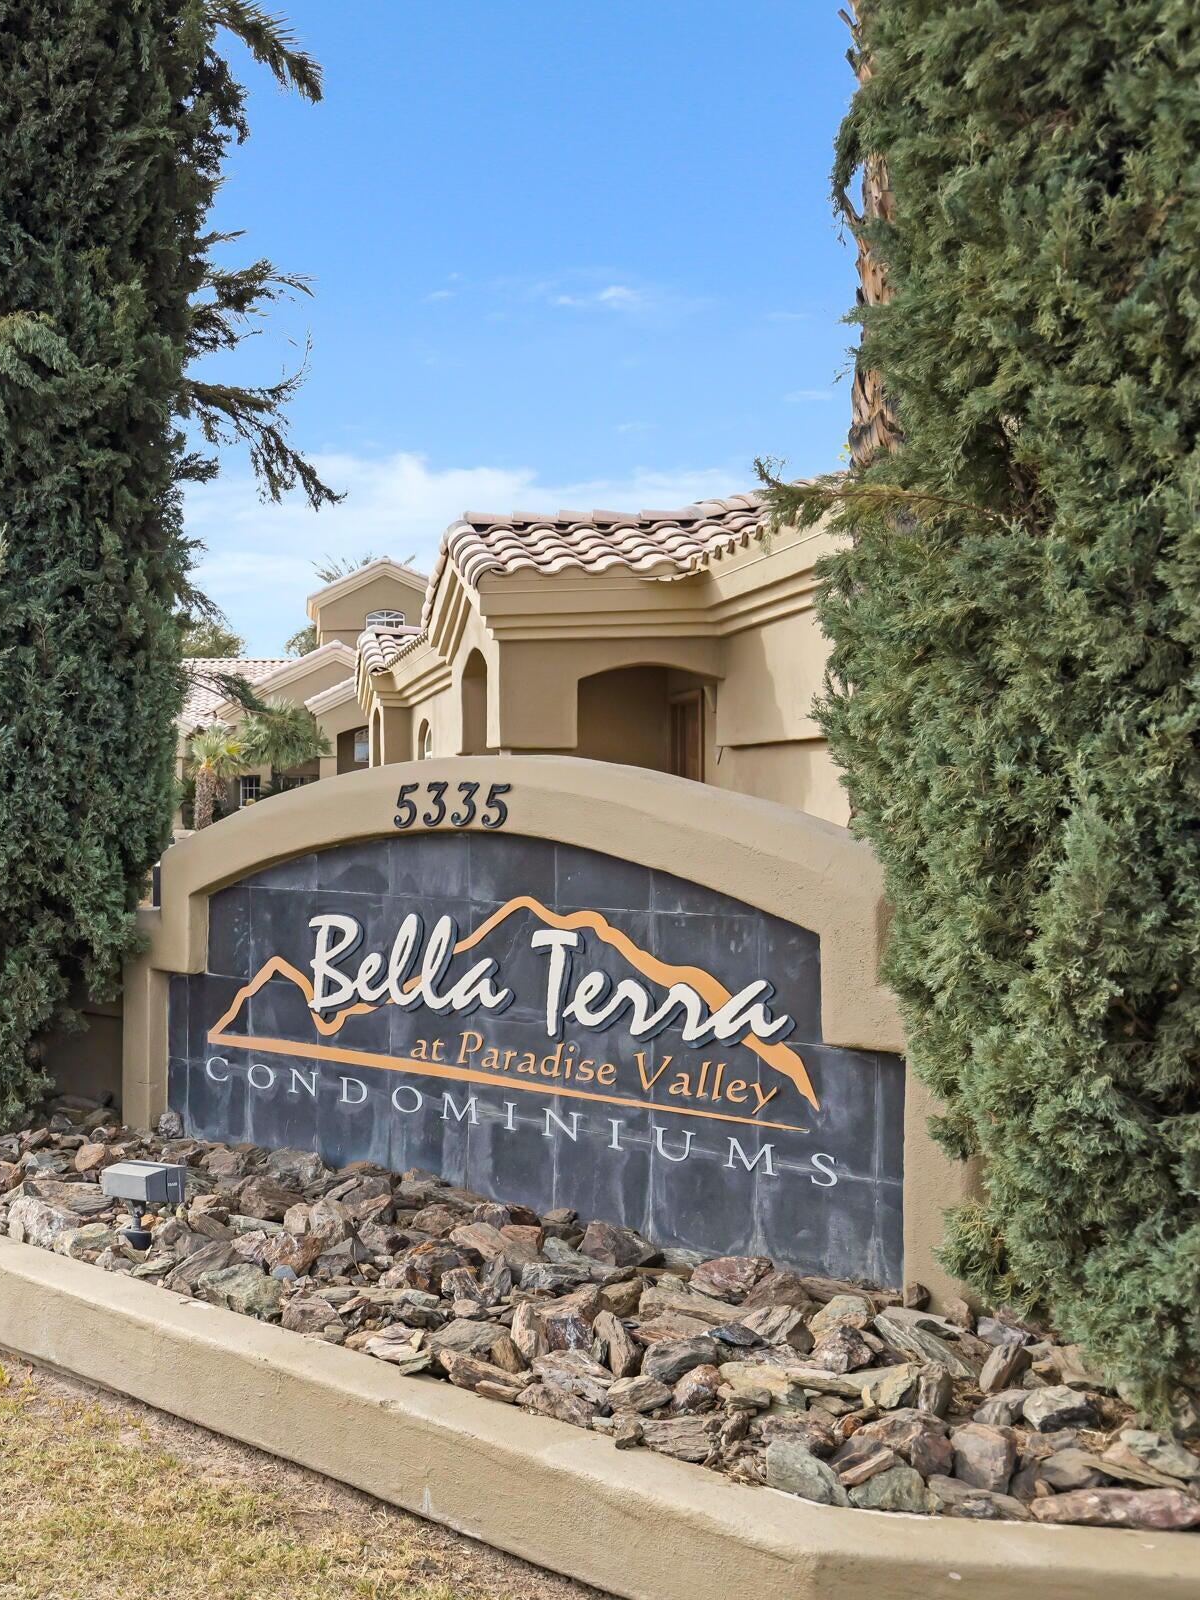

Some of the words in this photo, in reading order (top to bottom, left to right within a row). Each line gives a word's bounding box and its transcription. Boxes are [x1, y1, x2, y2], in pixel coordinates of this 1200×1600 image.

[393, 781, 512, 829] 5335
[309, 912, 512, 1015] Bella
[531, 928, 791, 1044] Terra
[205, 1056, 840, 1188] CONDOMINIUMS
[409, 1034, 445, 1060] at
[457, 1031, 617, 1086] Paradise
[633, 1051, 779, 1116] Valley
